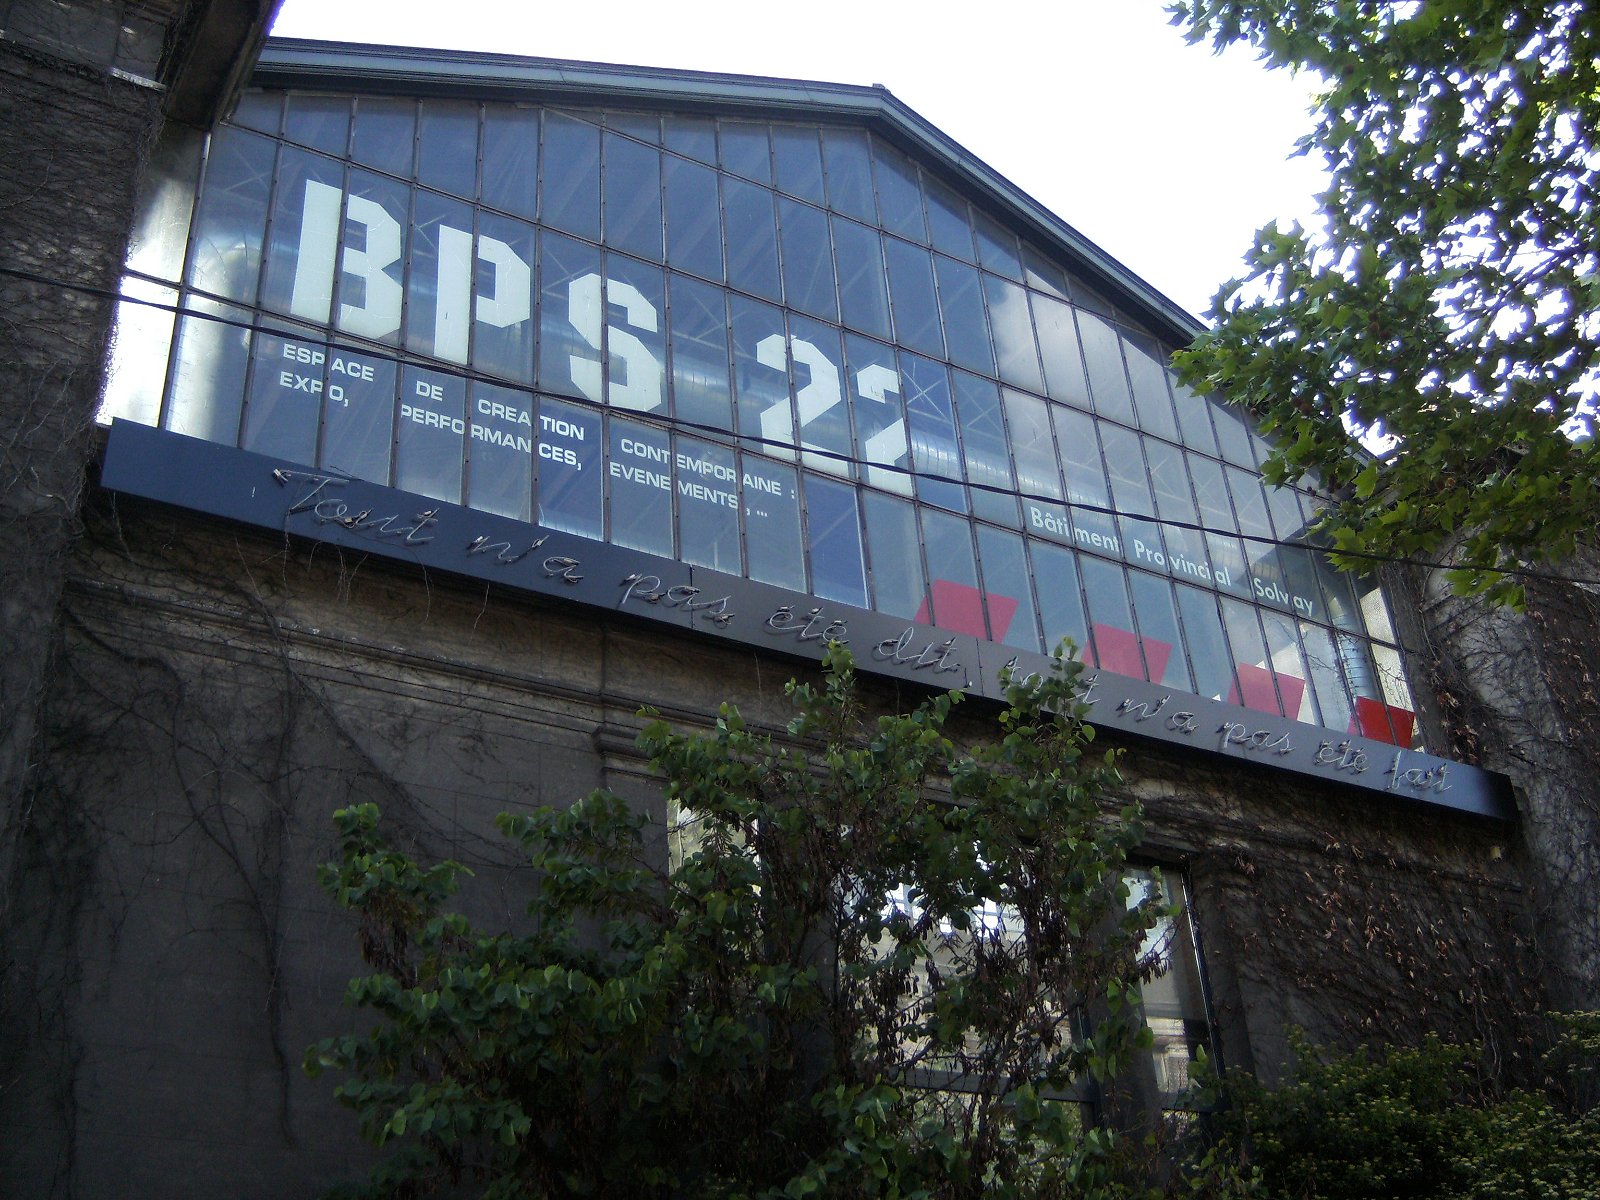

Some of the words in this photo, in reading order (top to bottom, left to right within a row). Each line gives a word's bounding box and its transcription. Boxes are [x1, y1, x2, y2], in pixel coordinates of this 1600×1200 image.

[290, 178, 662, 412] BPS
[278, 370, 350, 409] EXPO,
[400, 404, 584, 472] PERFORMANCES,
[282, 342, 375, 382] ESPACE
[415, 380, 444, 402] DE
[477, 398, 585, 442] CREATION
[620, 437, 782, 497] CONTEMPORAINE
[1029, 506, 1121, 553] Bâtiment
[1133, 538, 1232, 588] Provincial
[1253, 577, 1315, 617] Solvay
[621, 572, 735, 625] pas
[1222, 721, 1297, 754] pas
